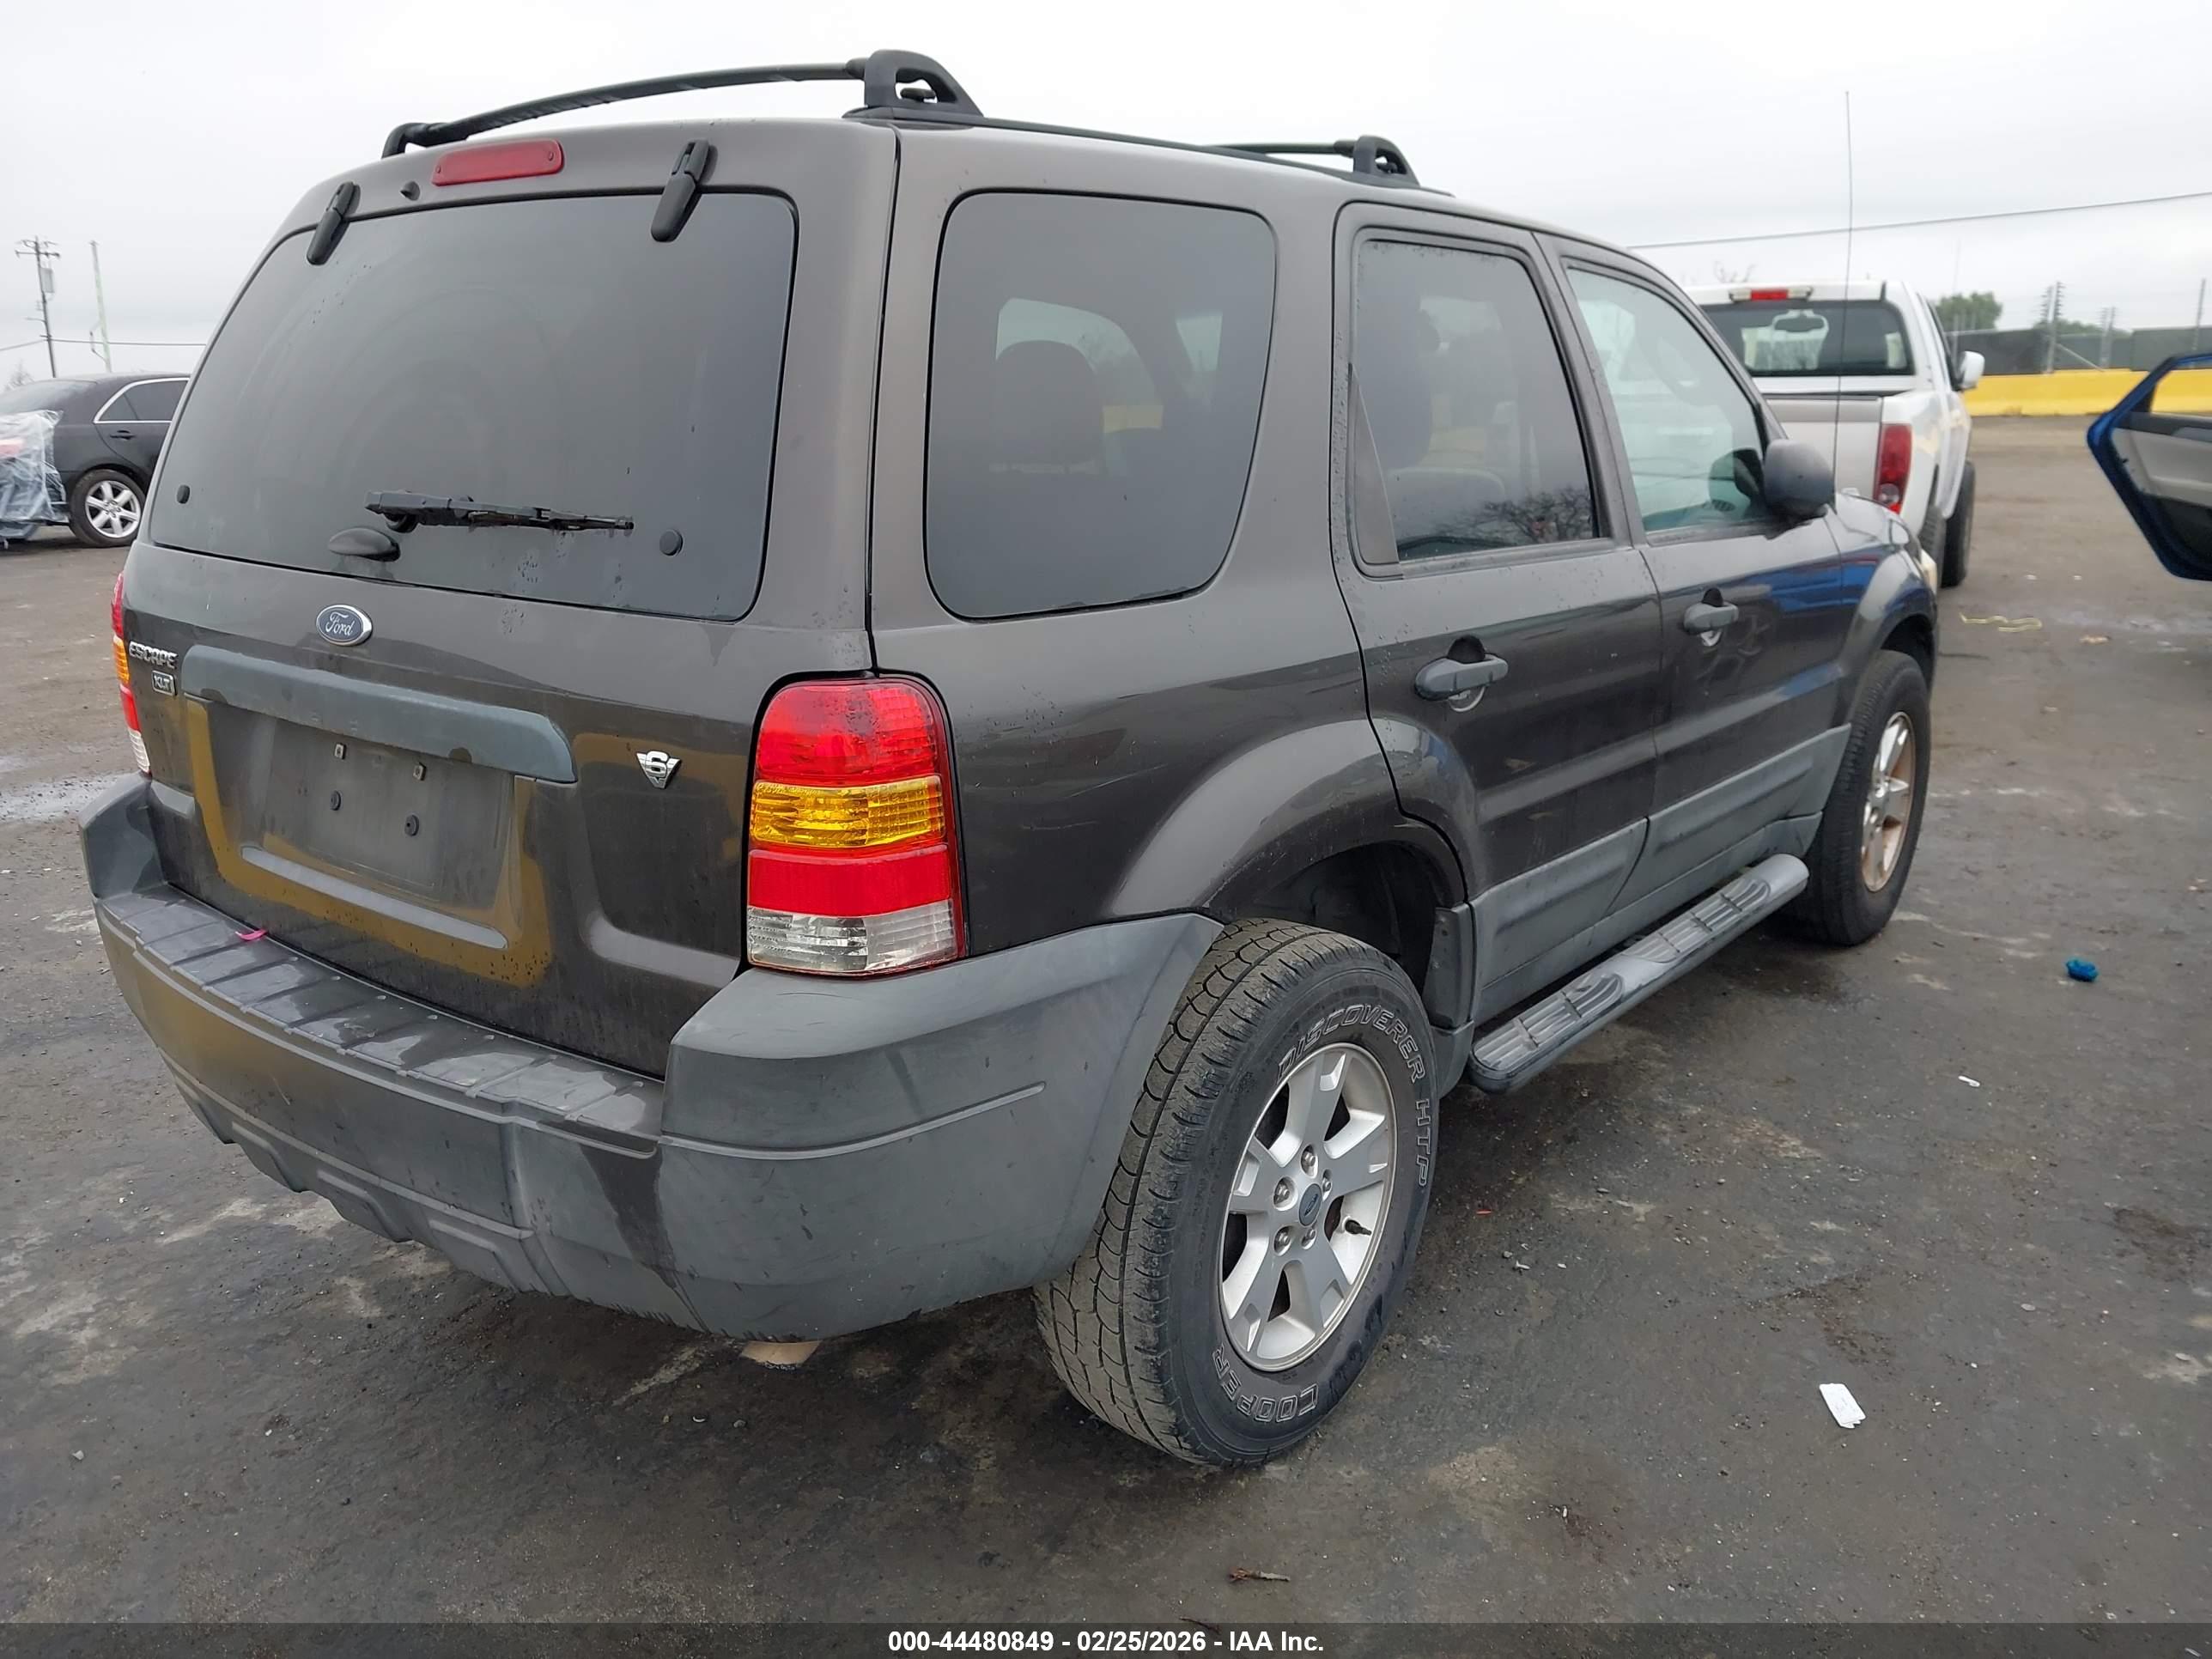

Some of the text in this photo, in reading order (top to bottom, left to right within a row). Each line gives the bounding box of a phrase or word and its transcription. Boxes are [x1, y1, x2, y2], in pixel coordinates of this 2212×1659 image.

[325, 611, 356, 635] Ford
[129, 641, 178, 669] ESCAPE
[1276, 1004, 1431, 1187] DISCOVERER HTP
[1212, 1342, 1318, 1423] COOPER
